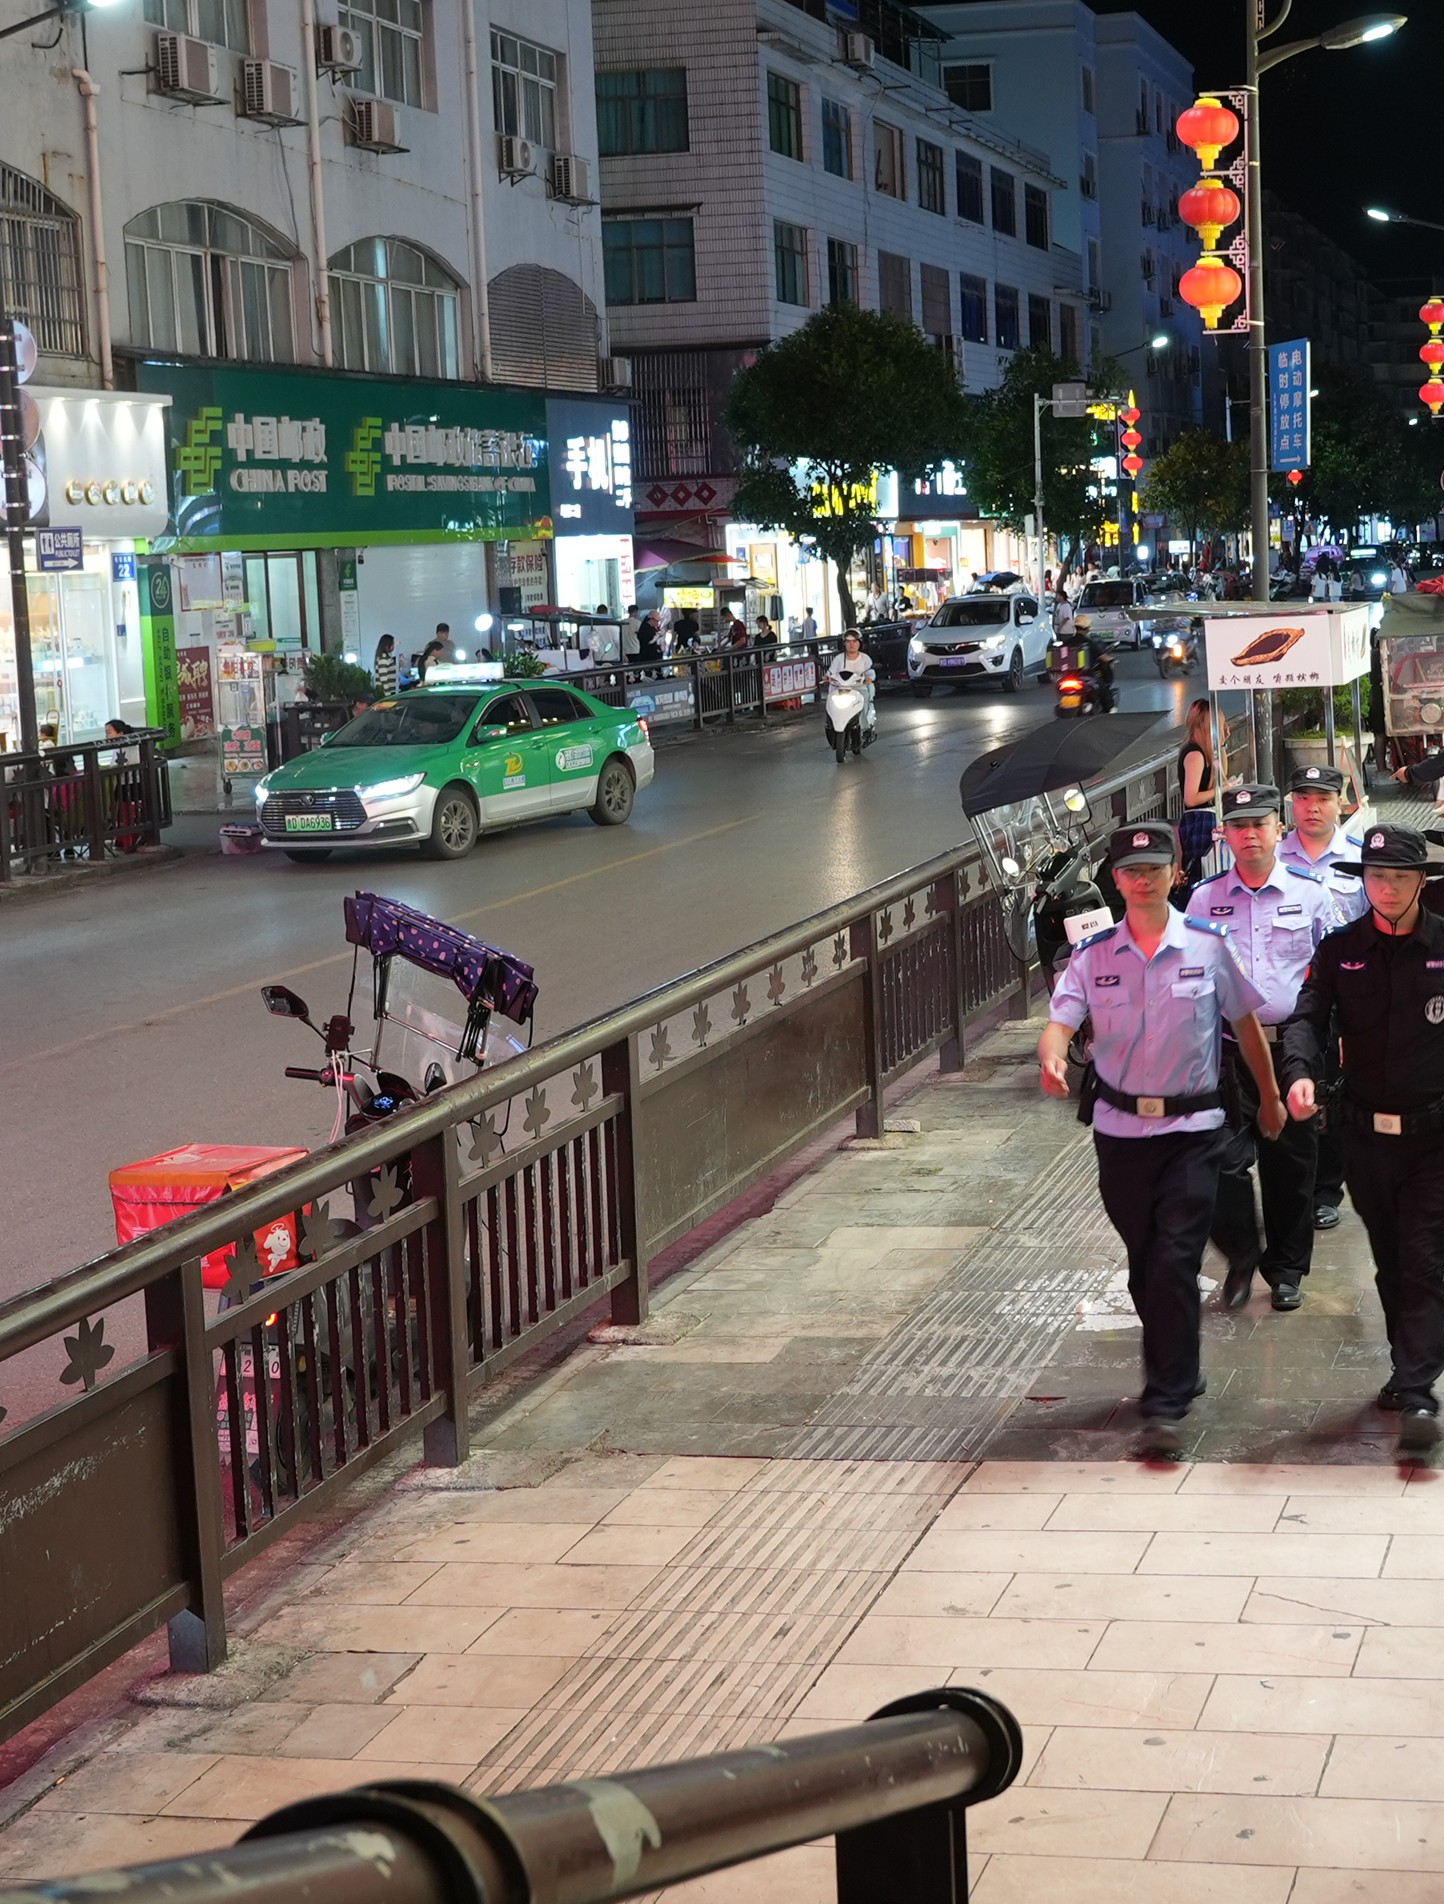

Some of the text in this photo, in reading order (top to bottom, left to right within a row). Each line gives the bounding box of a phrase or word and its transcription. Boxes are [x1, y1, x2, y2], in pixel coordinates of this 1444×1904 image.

[1278, 352, 1290, 450] 临时停放点
[1292, 349, 1303, 449] 电动摩托车
[226, 413, 328, 463] 中国邮政
[230, 469, 329, 493] CHINA POST
[118, 563, 131, 578] 22
[1219, 673, 1265, 685] 交个朋友
